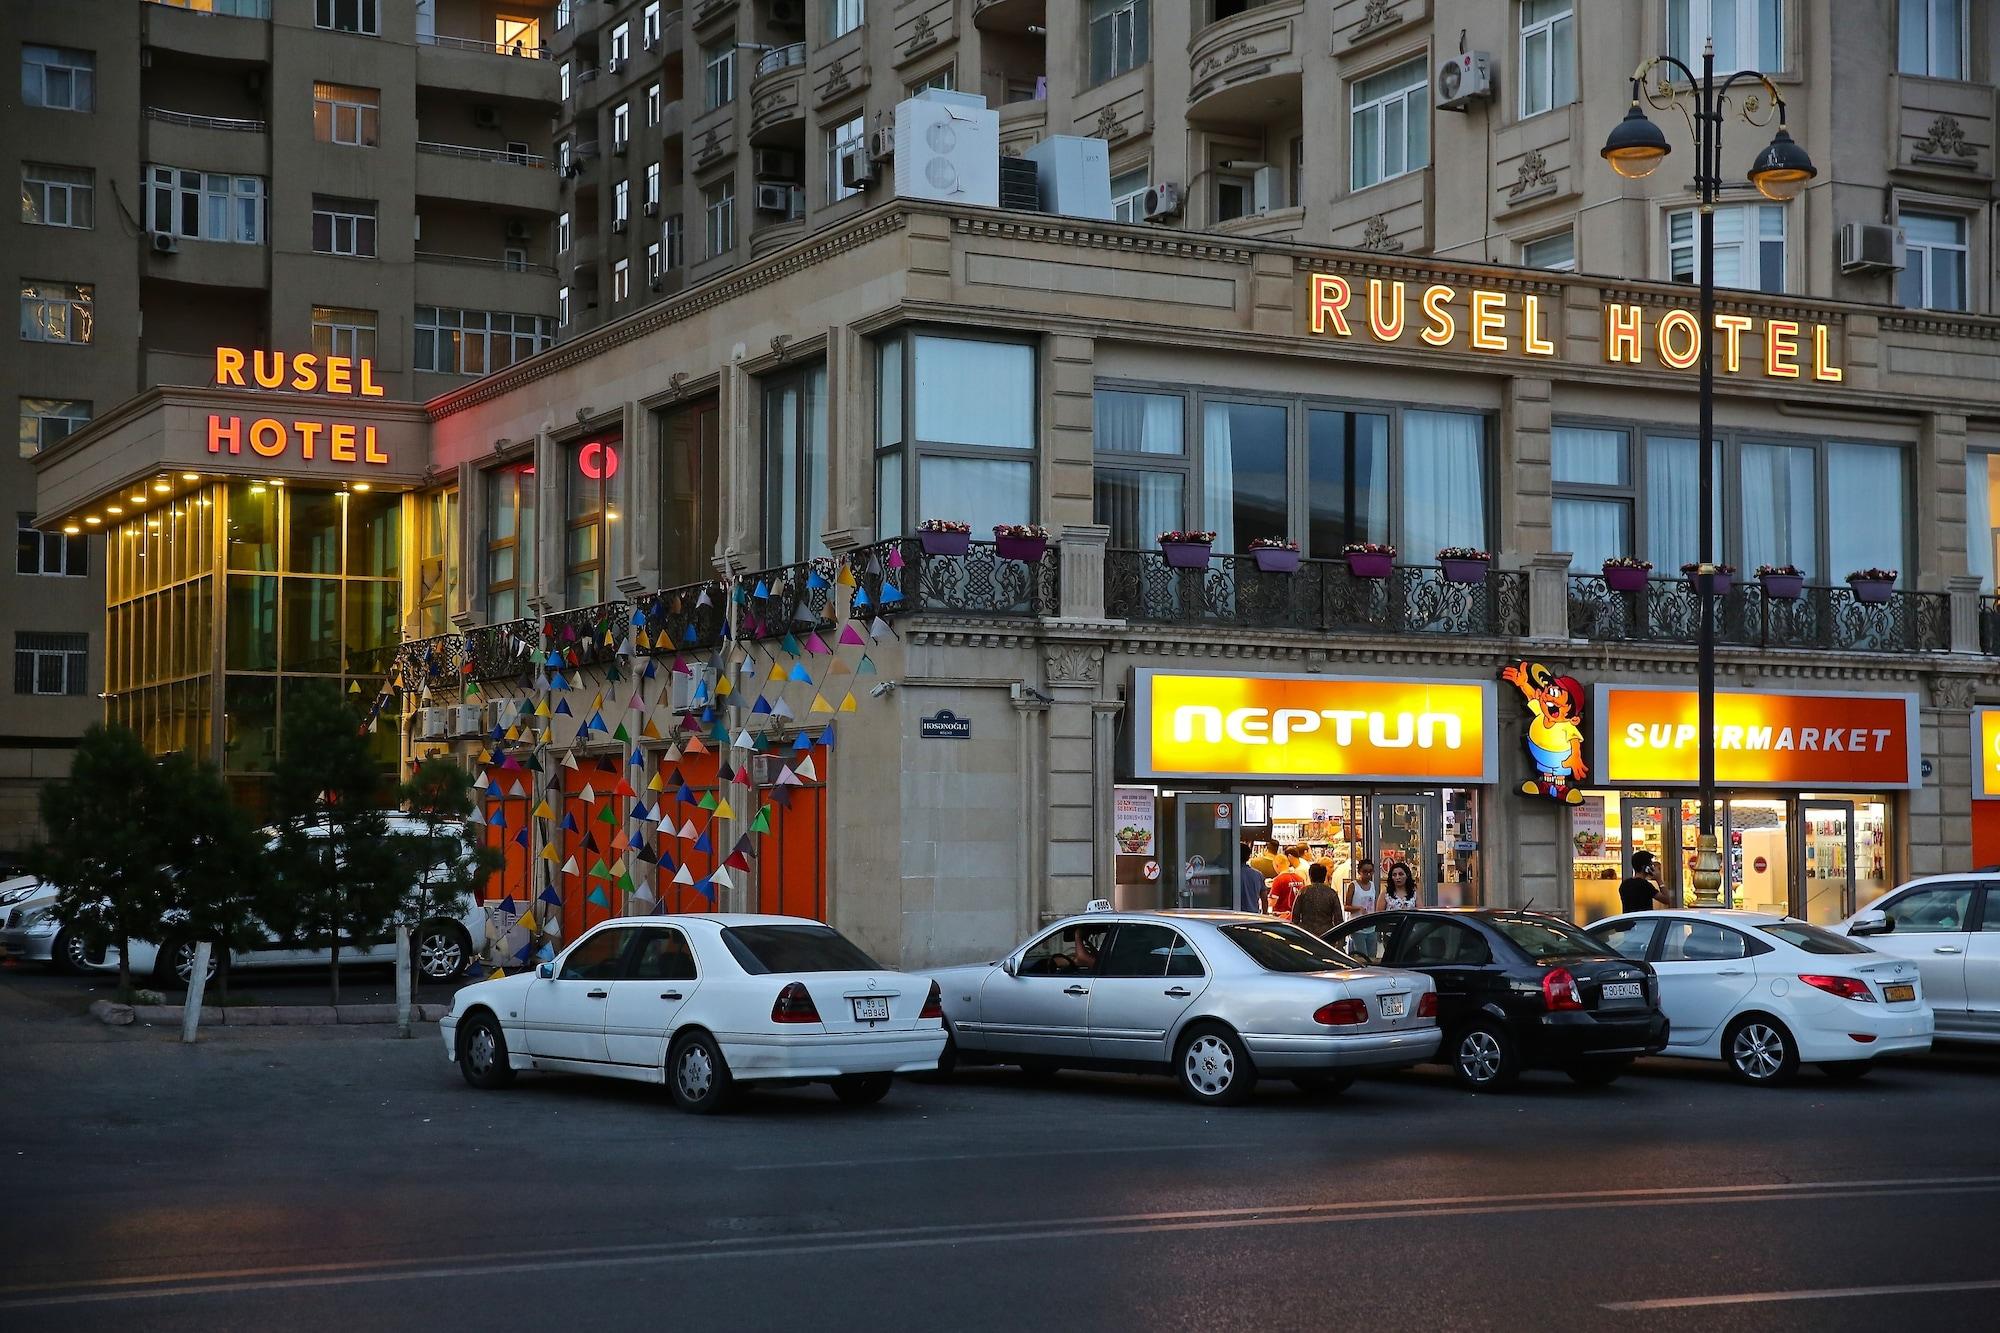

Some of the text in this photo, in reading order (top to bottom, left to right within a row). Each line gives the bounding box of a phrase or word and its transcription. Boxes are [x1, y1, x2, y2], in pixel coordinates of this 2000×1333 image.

[1309, 272, 1843, 382] RUSEL HOTEL
[215, 346, 385, 398] RUSEL
[207, 414, 389, 465] HOTEL
[1173, 705, 1462, 750] NEPTUN
[1624, 722, 1892, 752] SUPRMARKET
